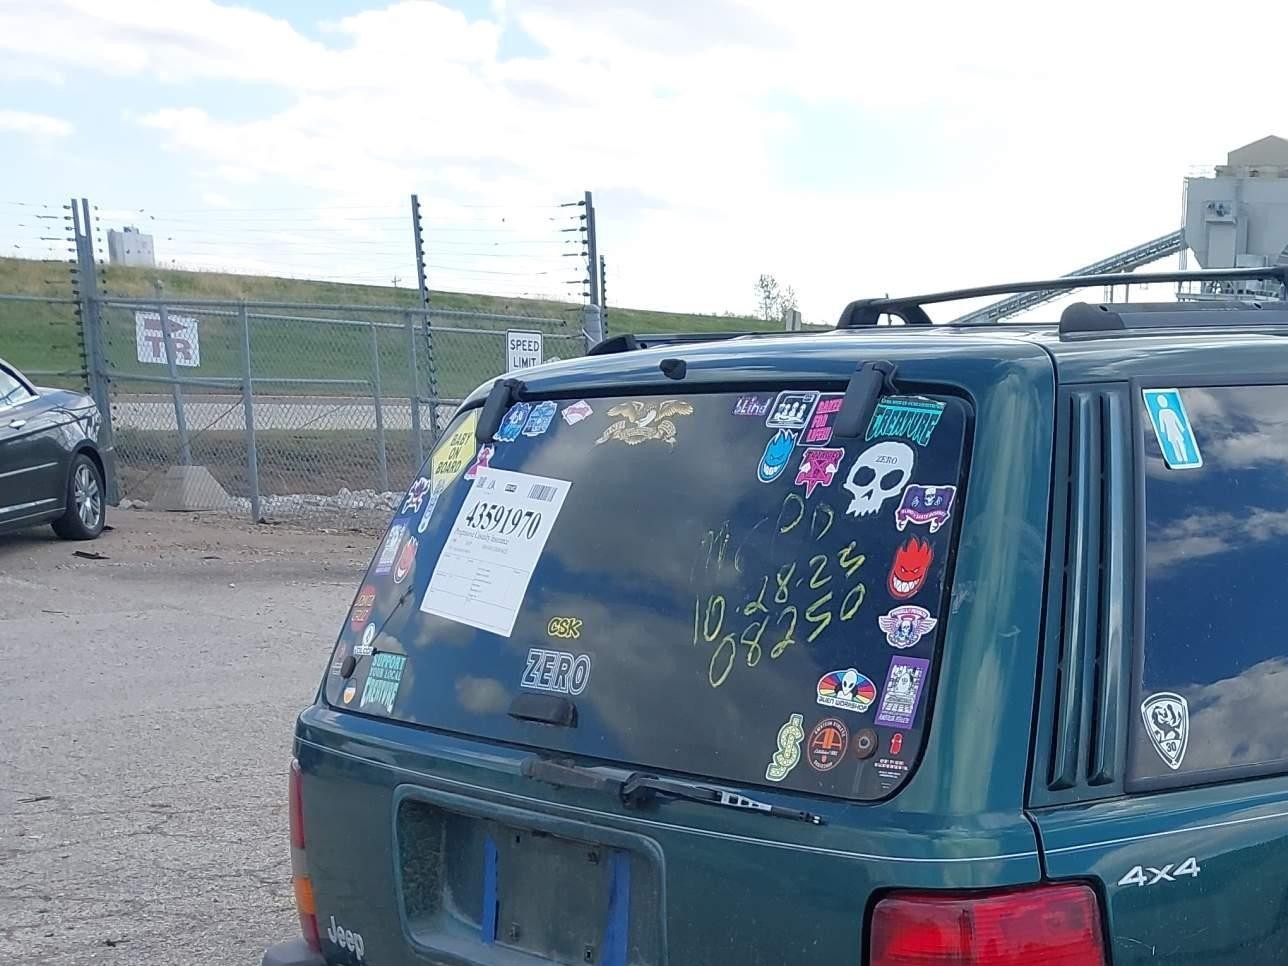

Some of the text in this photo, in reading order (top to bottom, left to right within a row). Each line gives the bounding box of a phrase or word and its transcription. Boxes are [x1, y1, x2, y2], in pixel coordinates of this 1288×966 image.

[510, 339, 540, 351] SPEED
[513, 356, 537, 368] LIMIT
[450, 431, 471, 447] BABY
[448, 447, 461, 461] ON
[875, 455, 898, 465] ZERO
[435, 459, 463, 475] BOARD
[465, 501, 542, 541] 43591970
[547, 617, 583, 638] CSK
[520, 648, 591, 695] ZERO
[1165, 741, 1177, 752] 30
[327, 915, 365, 961] Jeep
